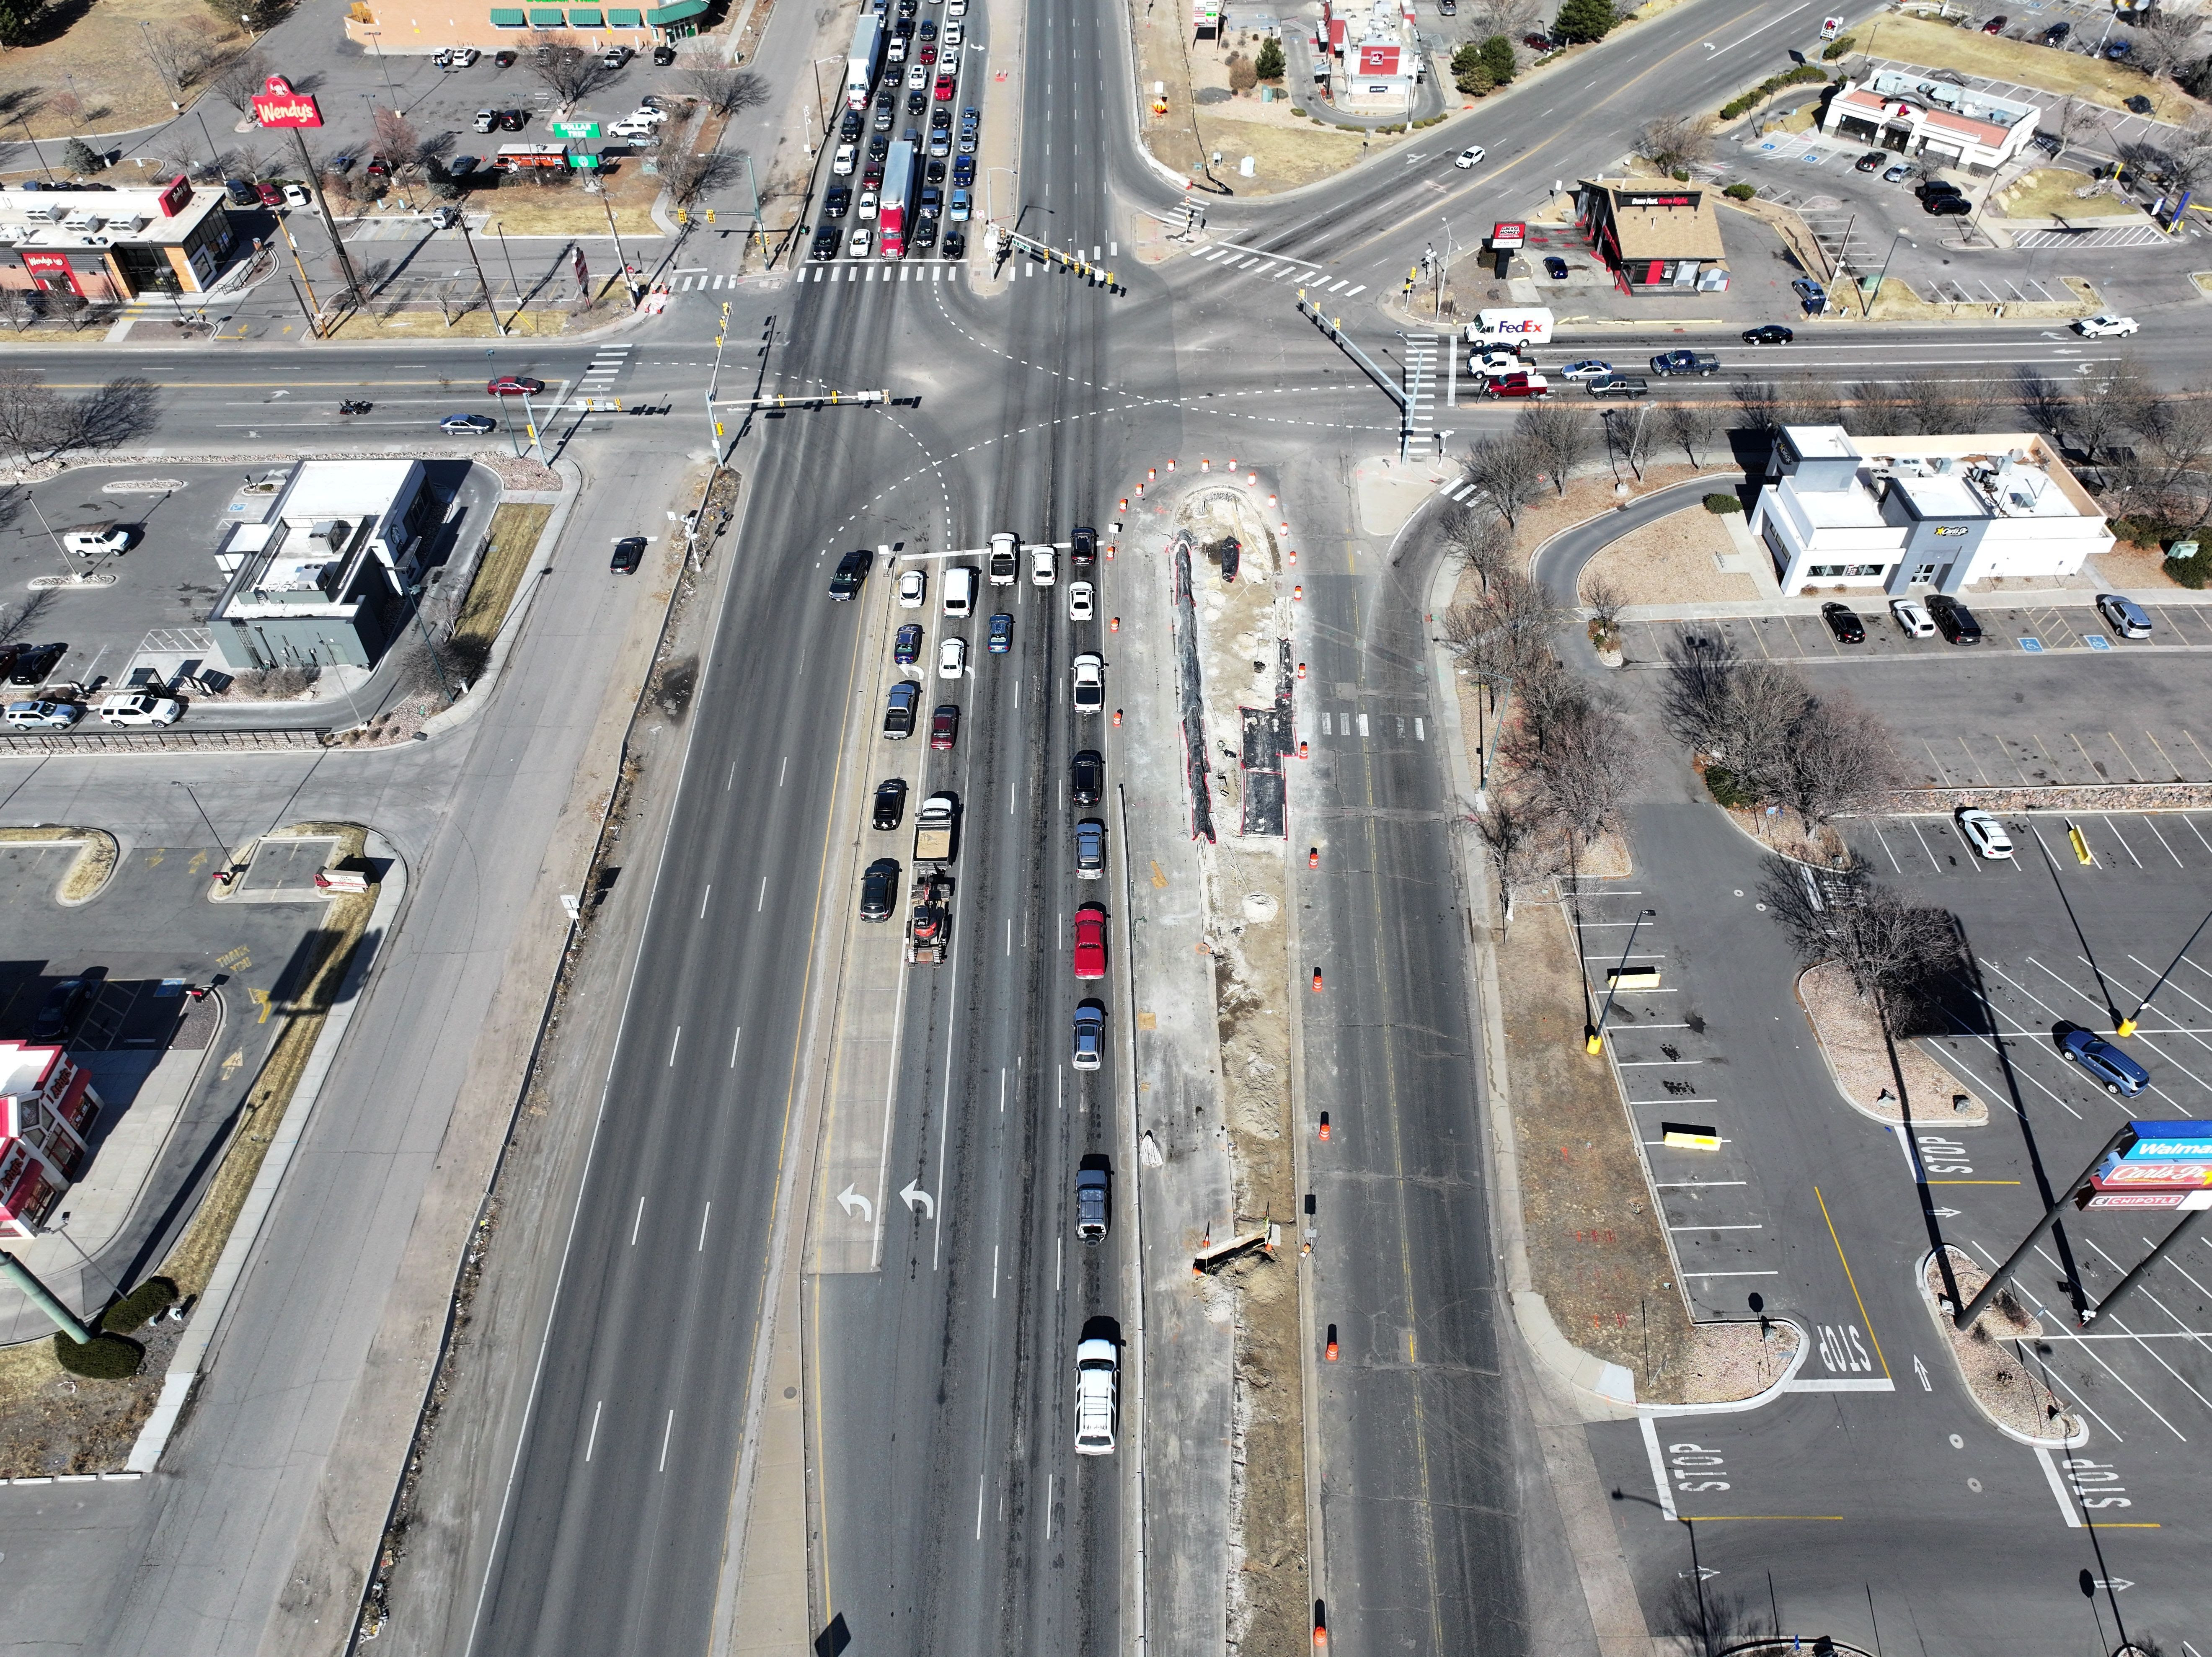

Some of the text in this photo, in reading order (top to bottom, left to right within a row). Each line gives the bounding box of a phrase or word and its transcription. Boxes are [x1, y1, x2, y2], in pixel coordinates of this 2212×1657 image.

[258, 100, 314, 123] Wendy's
[28, 256, 53, 266] Wendy's
[1499, 320, 1543, 333] FedEx
[50, 1068, 72, 1099] Arby's
[1918, 1136, 1973, 1173] STOP
[0, 1158, 23, 1192] Arby's
[2113, 1166, 2175, 1180] Carl's
[1817, 1325, 1871, 1372] STOP
[1669, 1443, 1731, 1491] STOP
[2062, 1459, 2132, 1508] STOP
